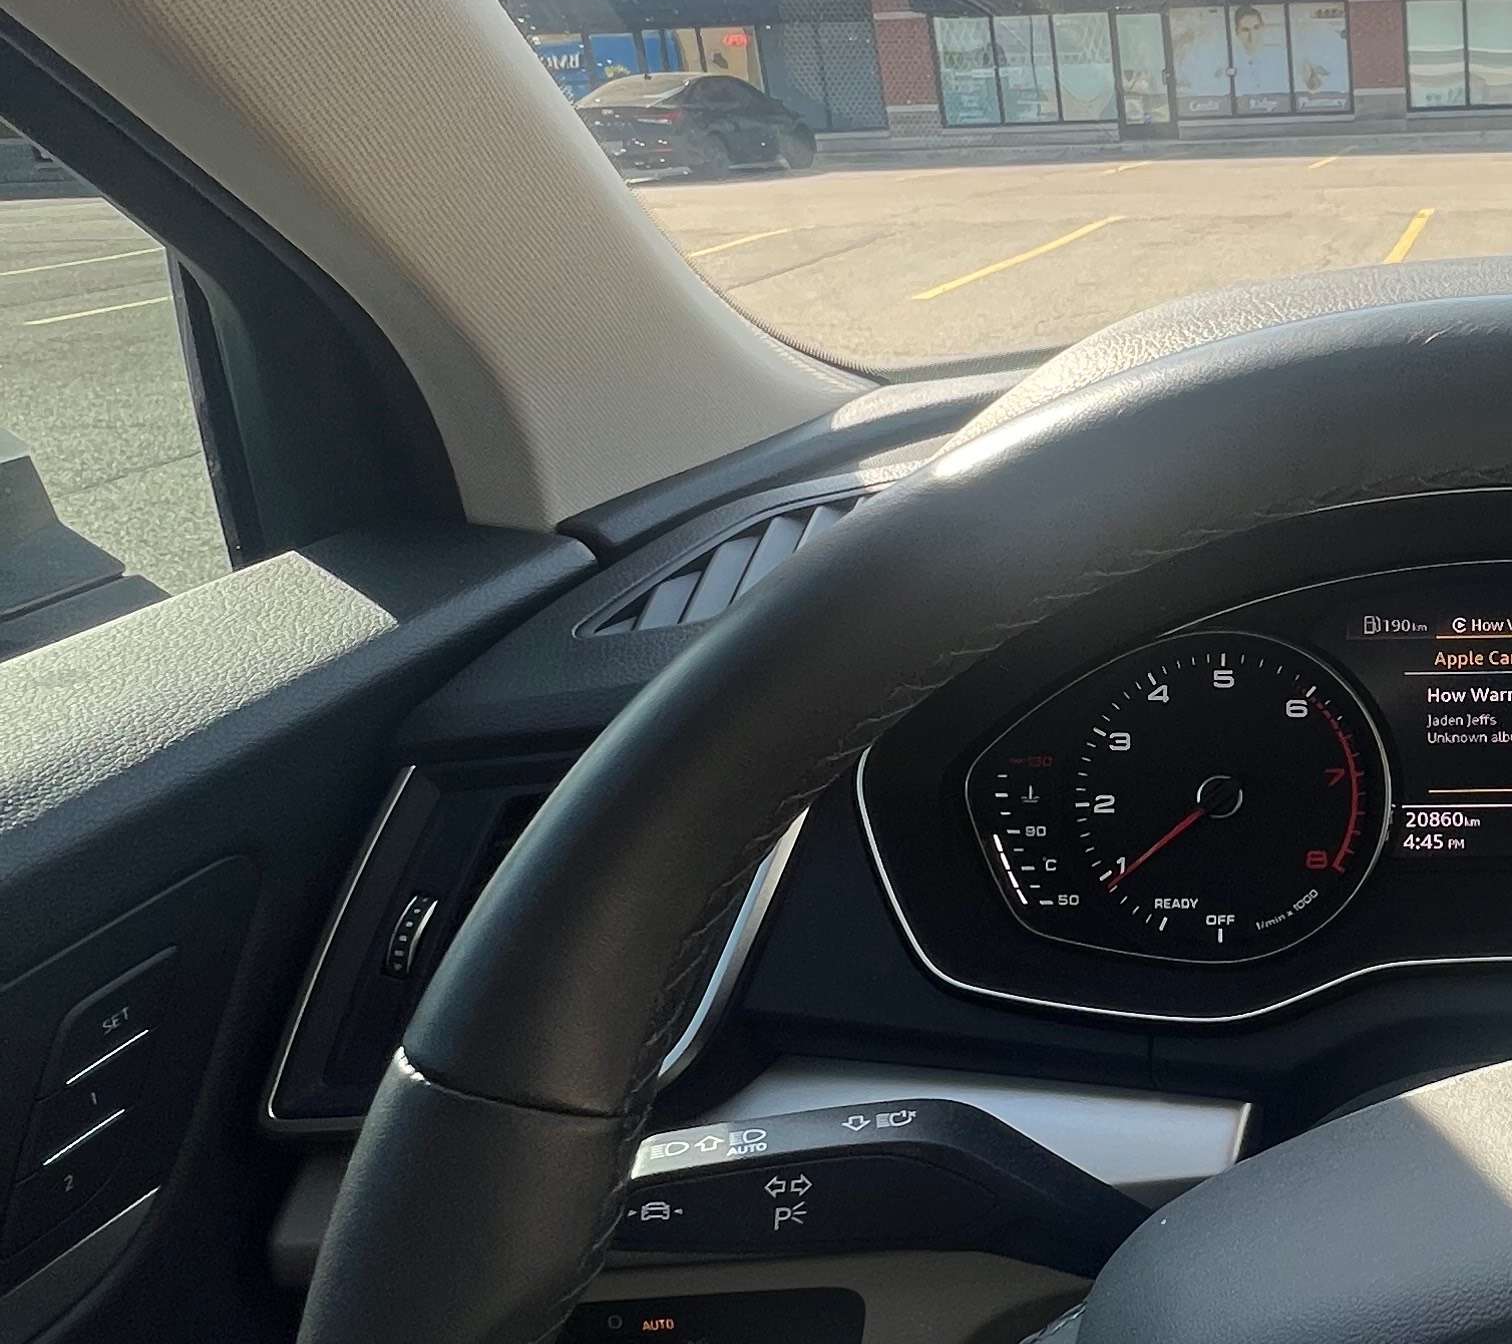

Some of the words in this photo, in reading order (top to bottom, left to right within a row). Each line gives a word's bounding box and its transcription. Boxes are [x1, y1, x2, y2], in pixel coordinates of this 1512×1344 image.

[1471, 618, 1504, 632] How
[1434, 651, 1484, 668] Apple
[1213, 670, 1235, 688] 5
[1147, 685, 1169, 702] 4
[1427, 688, 1466, 703] How
[1286, 700, 1308, 718] 6
[1426, 714, 1464, 728] Jaden
[1466, 713, 1497, 728] Jeffs
[1109, 733, 1131, 751] 3
[1427, 731, 1487, 744] Unknown
[1325, 769, 1345, 786] 7
[1093, 794, 1115, 813] 2
[1025, 826, 1047, 837] 90
[1403, 833, 1444, 850] 4:45
[1448, 838, 1465, 849] PM
[1116, 857, 1126, 874] 1
[1306, 851, 1328, 869] 8
[1058, 894, 1080, 907] 50
[1154, 898, 1199, 910] READY
[1293, 889, 1318, 912] 1000
[1206, 914, 1235, 927] OFF
[102, 1007, 130, 1033] SET
[727, 1141, 767, 1156] AUTO
[63, 1175, 75, 1192] 2
[642, 1318, 675, 1332] AUTO
